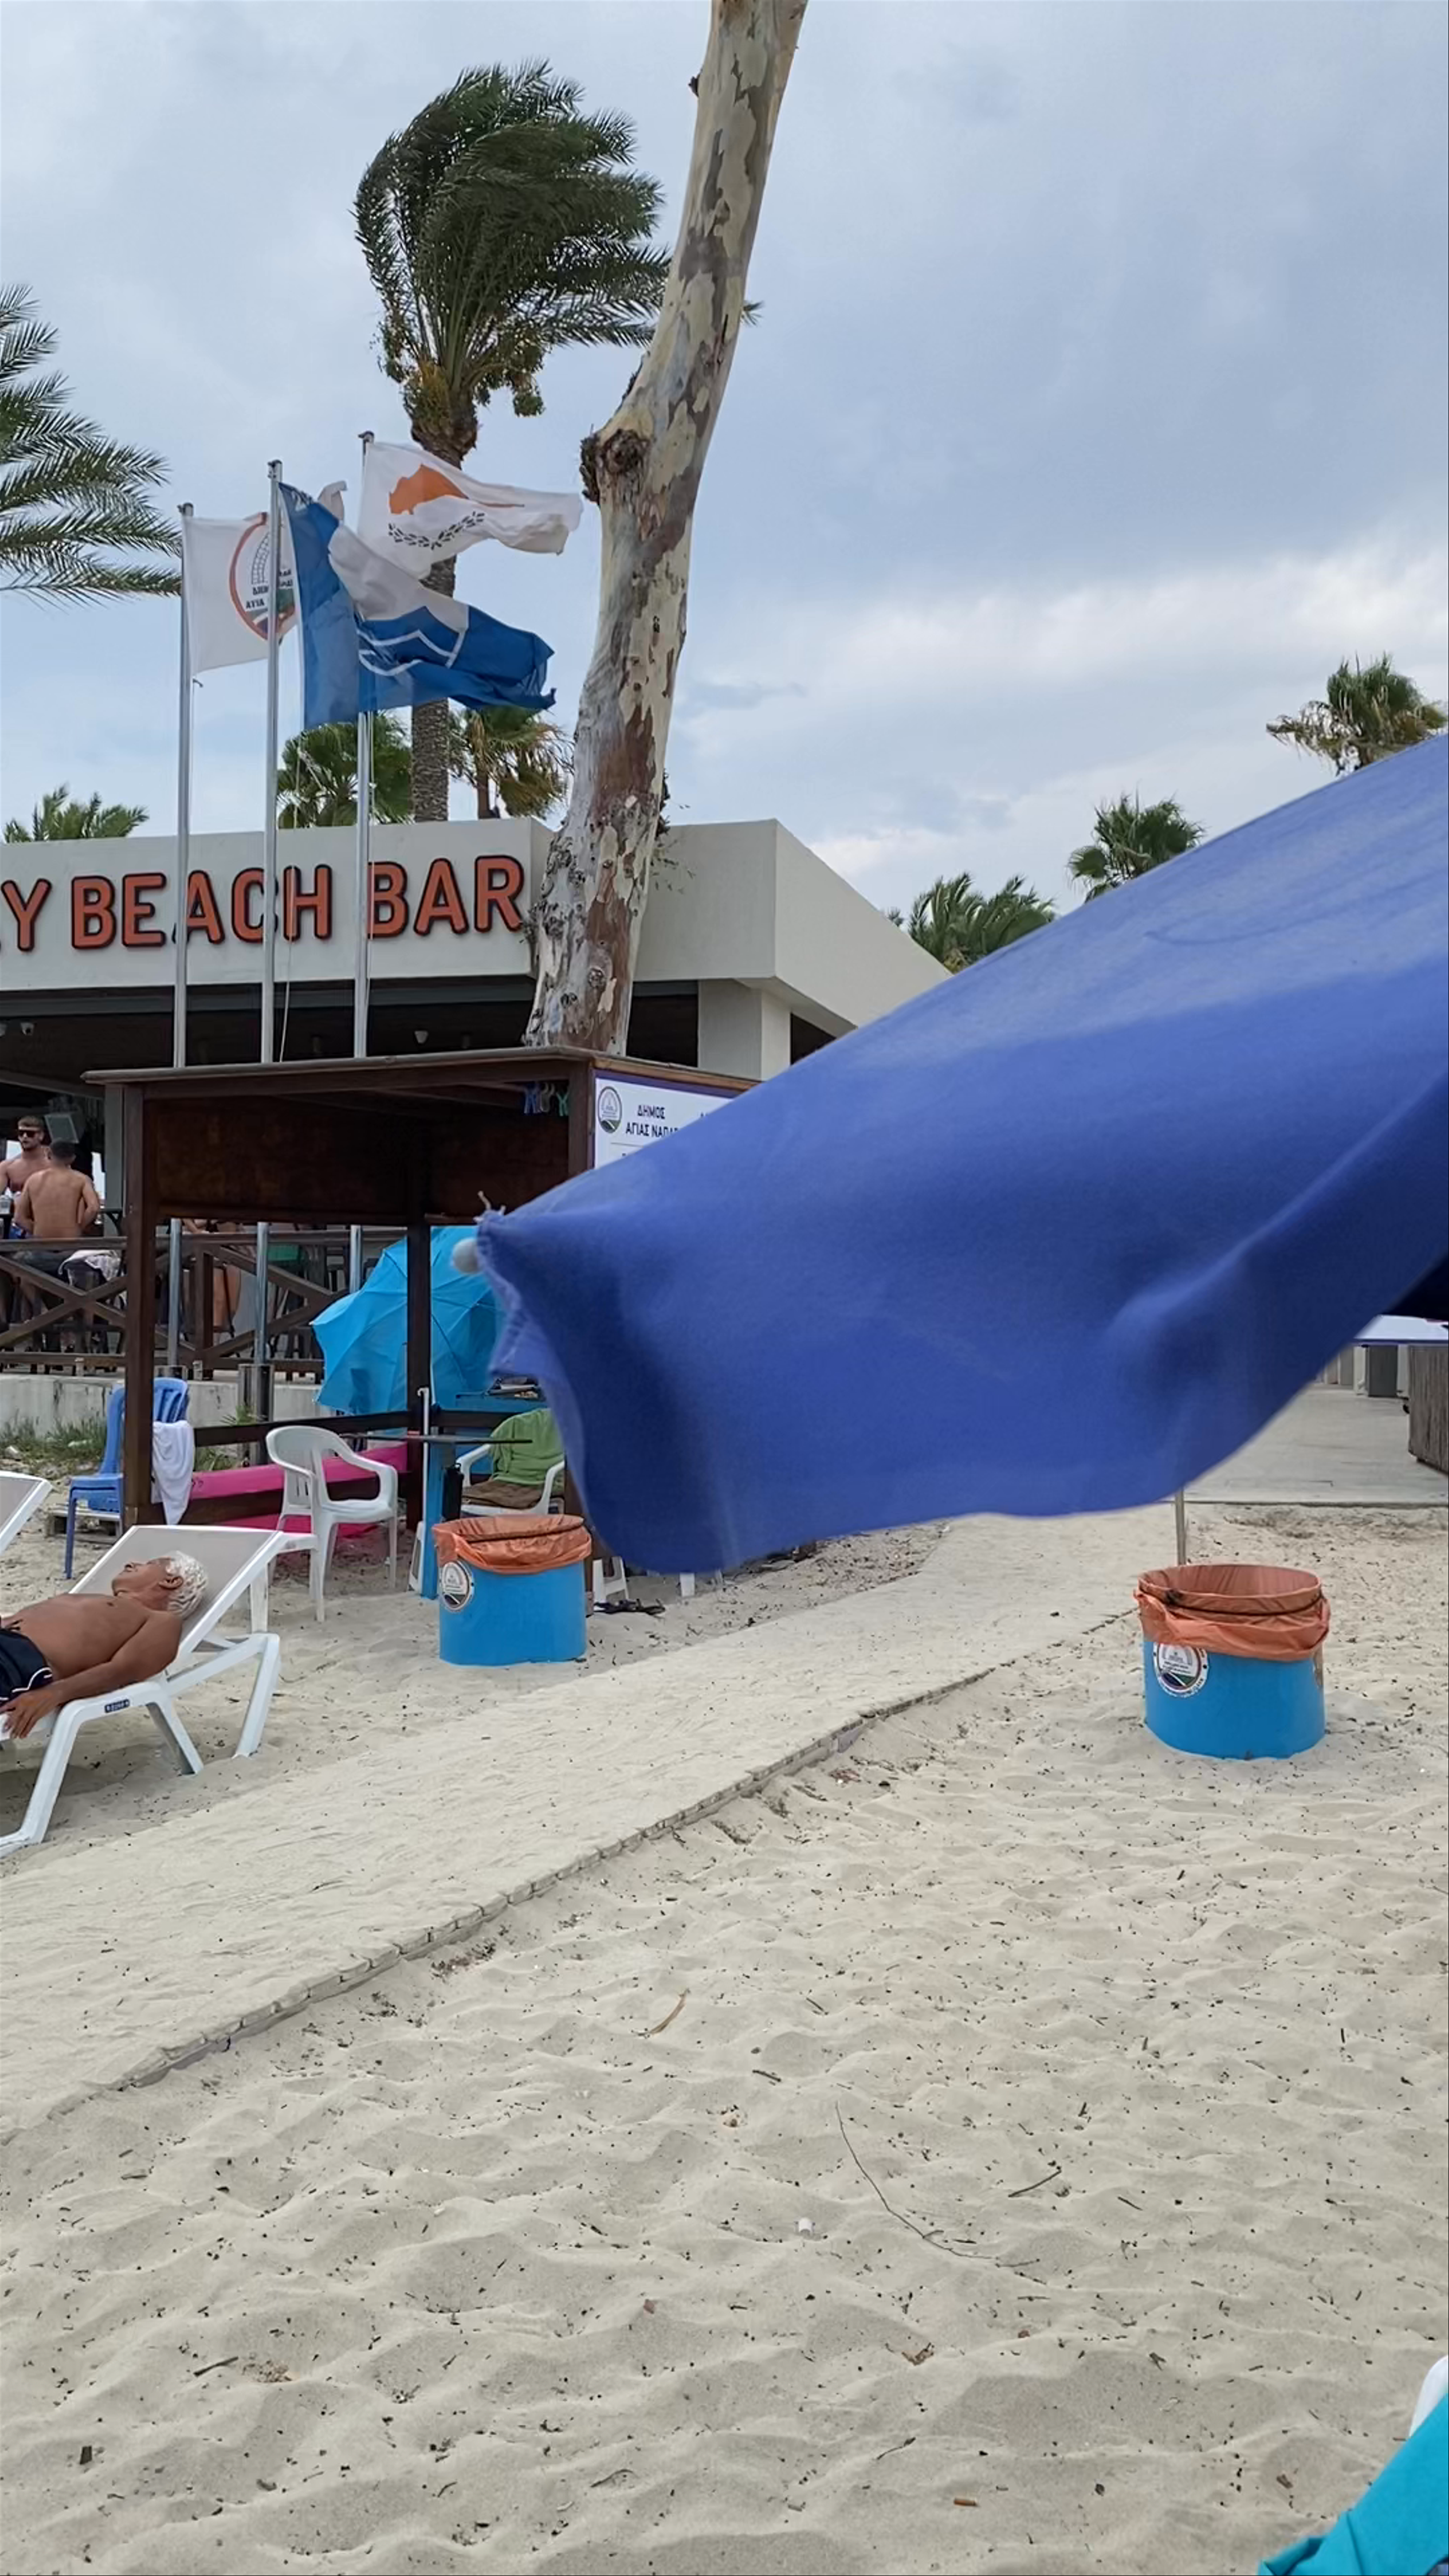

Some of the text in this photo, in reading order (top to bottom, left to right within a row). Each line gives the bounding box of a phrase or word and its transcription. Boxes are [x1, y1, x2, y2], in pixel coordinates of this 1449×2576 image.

[0, 855, 524, 952] Y BEACH BAR
[638, 1104, 665, 1120] ΔΗΜΟΣ
